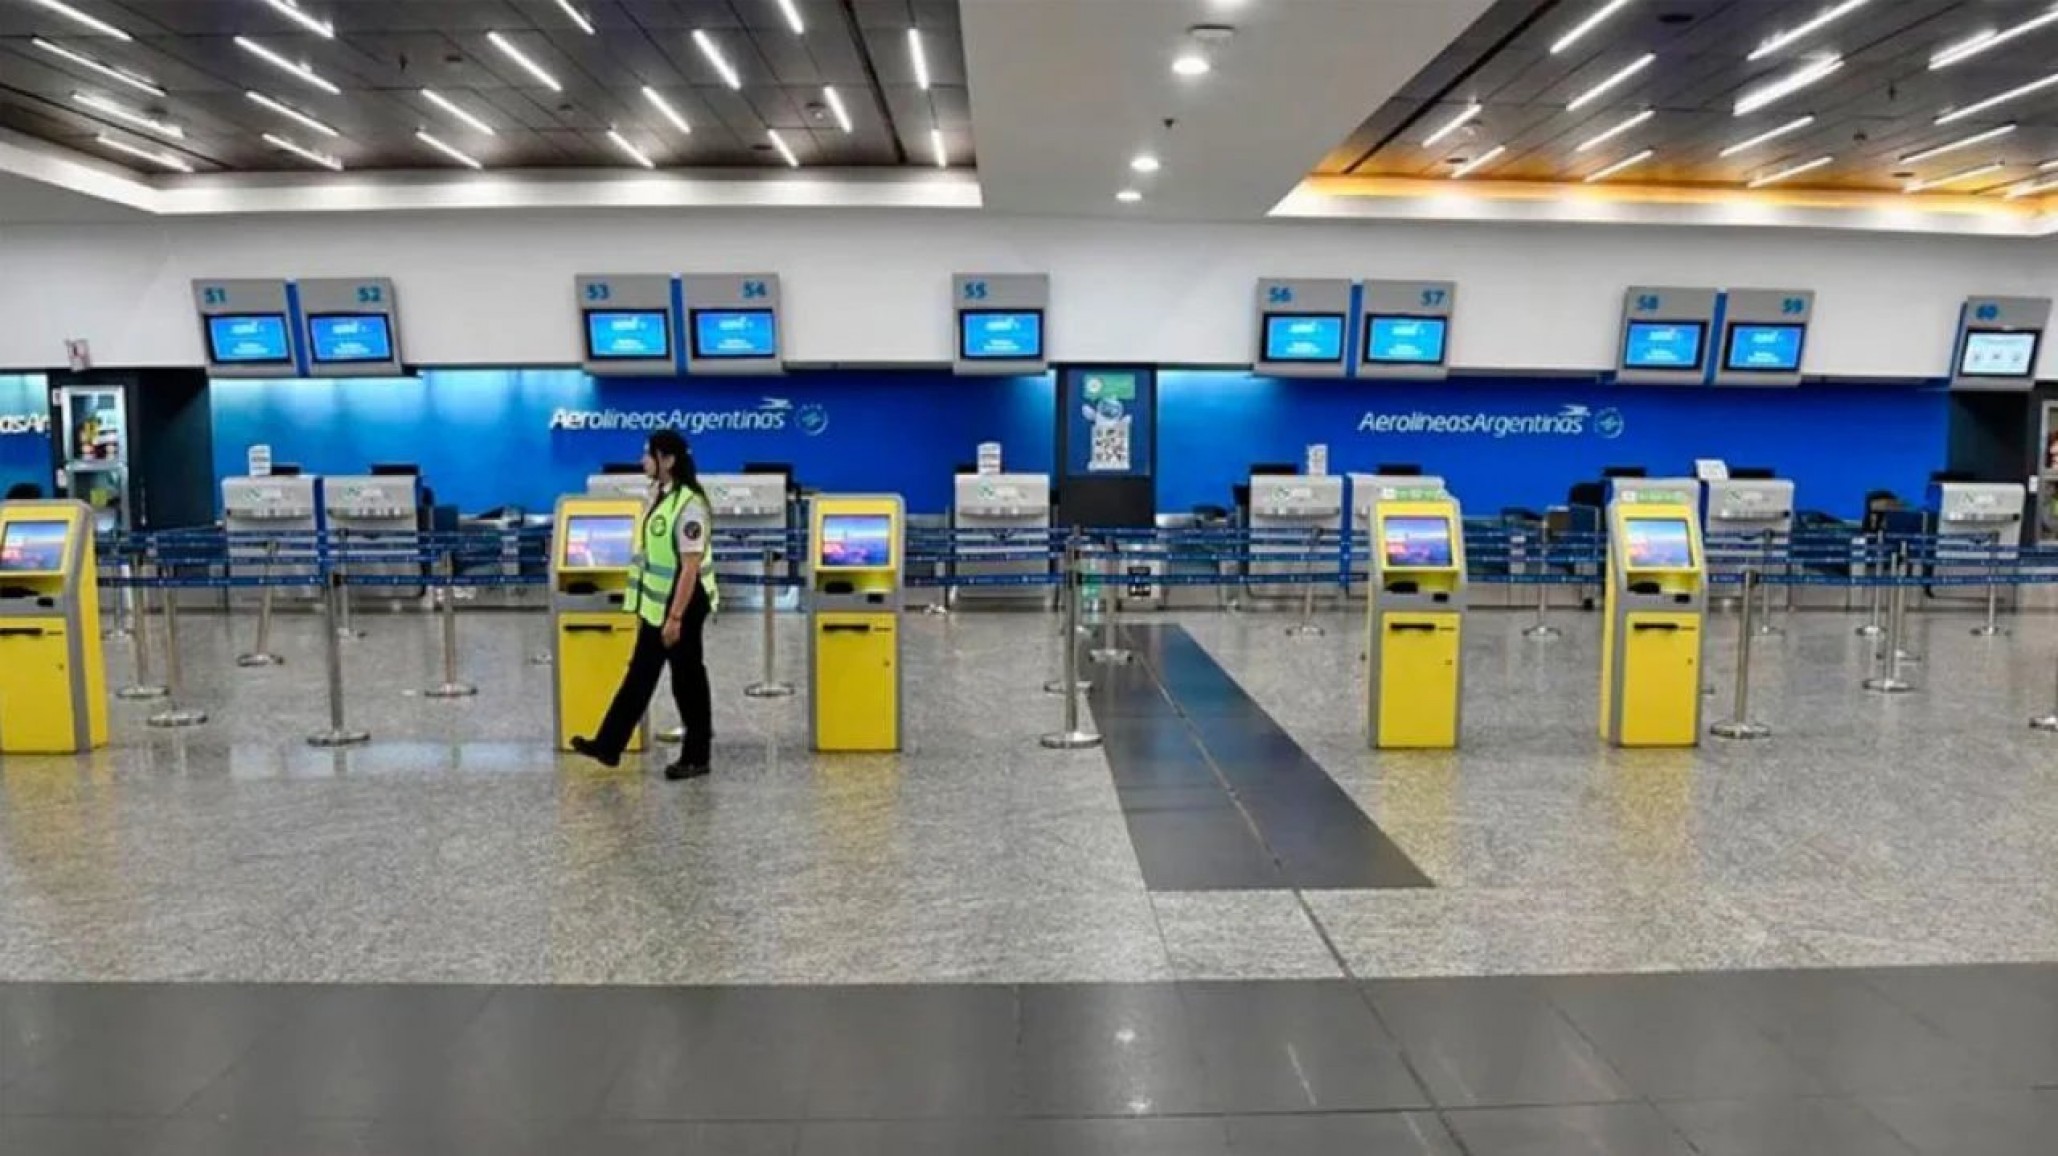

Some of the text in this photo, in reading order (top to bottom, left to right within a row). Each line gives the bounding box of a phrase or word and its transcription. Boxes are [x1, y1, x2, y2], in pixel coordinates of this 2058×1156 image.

[358, 285, 382, 303] 52
[586, 283, 610, 300] 53
[743, 281, 767, 298] 54
[964, 282, 986, 299] 55
[1268, 286, 1292, 303] 56
[1421, 290, 1445, 307] 57
